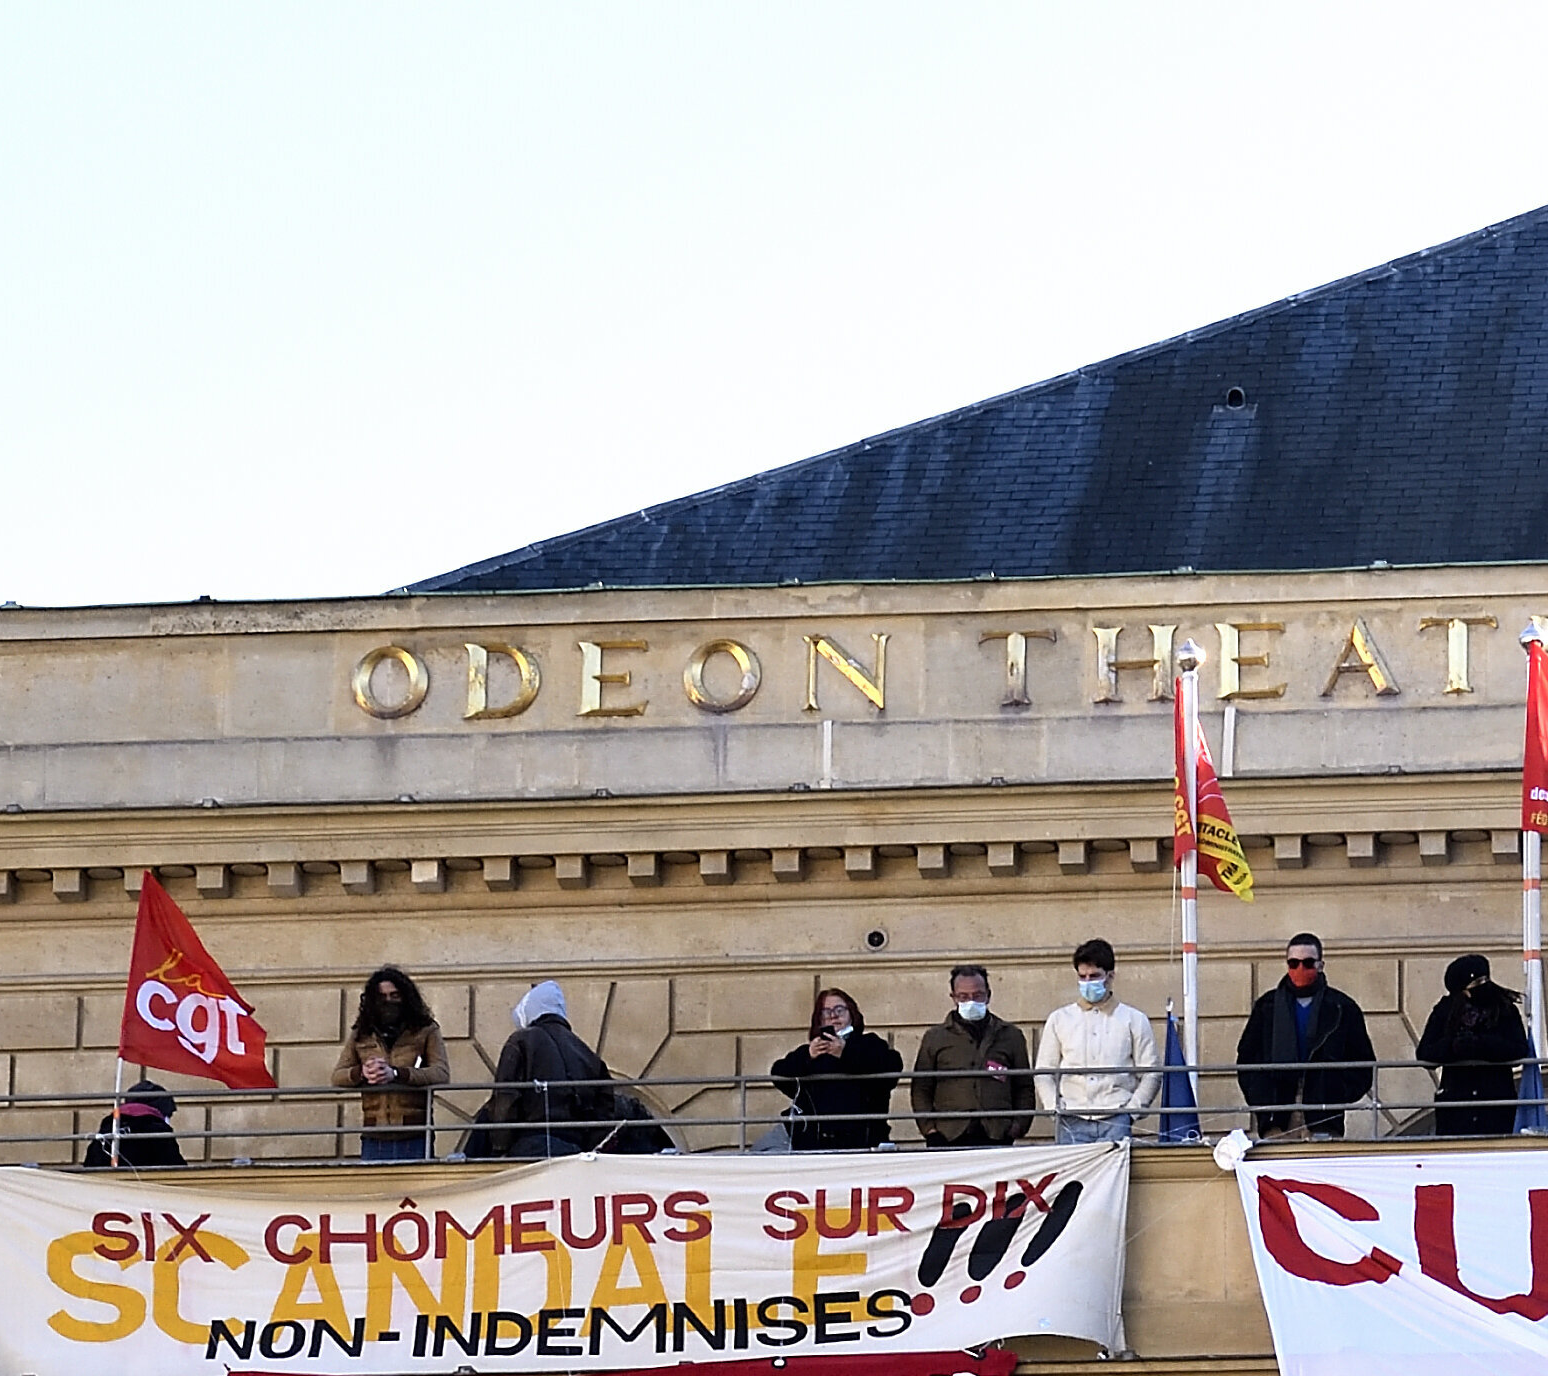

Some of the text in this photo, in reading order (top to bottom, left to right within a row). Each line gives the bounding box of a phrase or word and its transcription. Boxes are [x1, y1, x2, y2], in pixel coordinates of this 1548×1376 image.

[351, 632, 890, 720] ODEON
[136, 980, 248, 1064] cgt
[92, 1172, 1058, 1265] SIX CHÔMEURS SUR DIX
